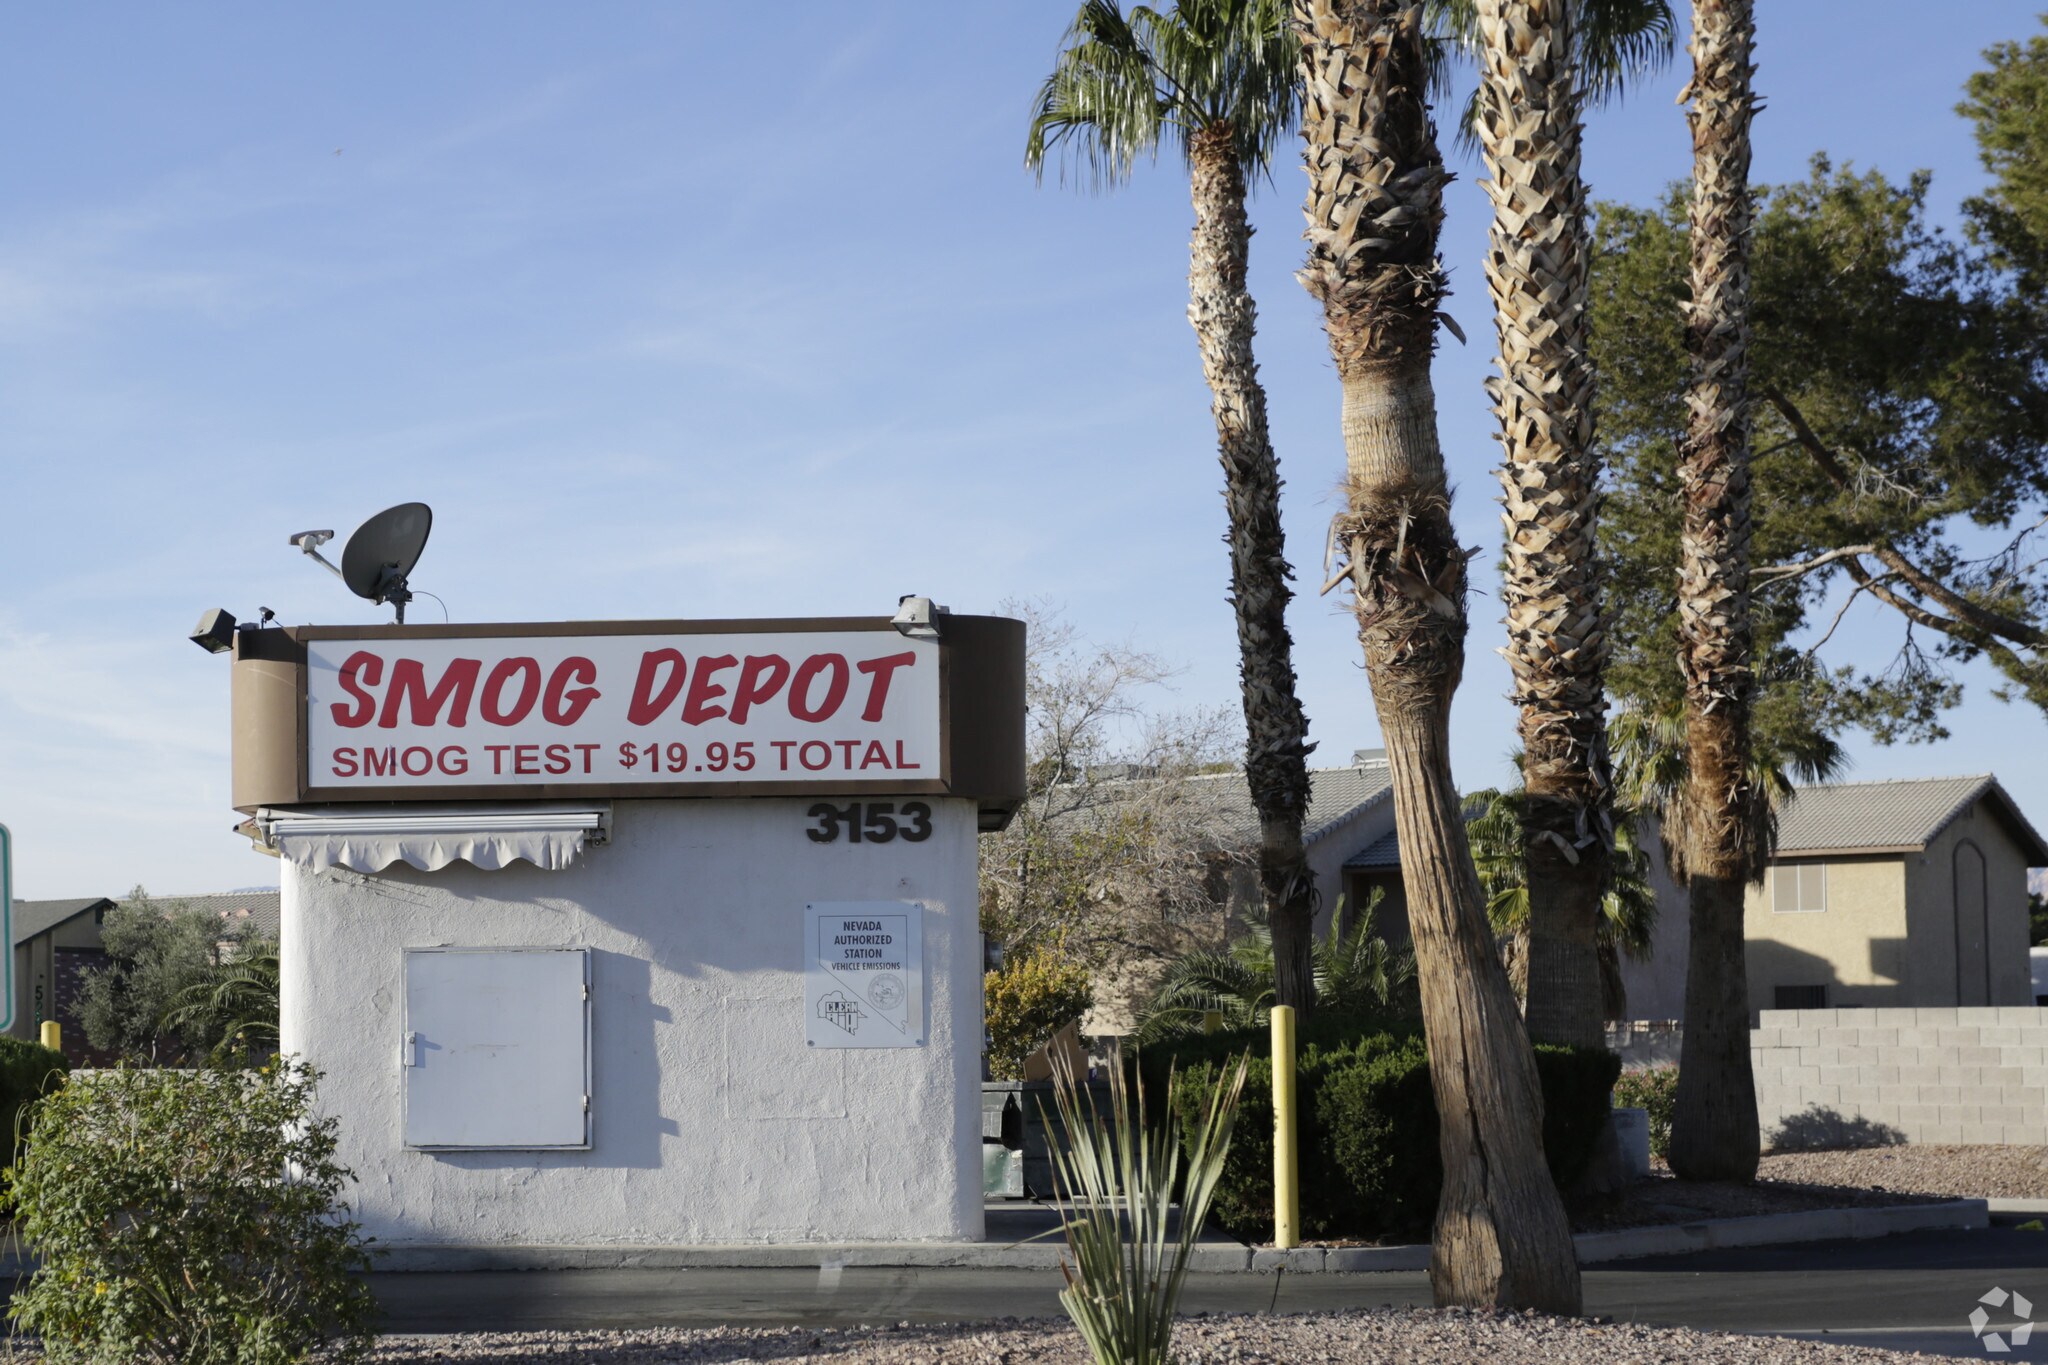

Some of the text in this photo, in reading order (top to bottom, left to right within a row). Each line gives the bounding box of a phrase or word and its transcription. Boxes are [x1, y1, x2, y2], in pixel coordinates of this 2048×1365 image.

[330, 648, 916, 728] SMOG DEPOT
[333, 740, 920, 777] SMOG TEST $19.95 TOTAL
[807, 802, 932, 844] 3153
[843, 921, 882, 931] NEVADA
[834, 935, 892, 945] AUTHORIZED
[844, 949, 882, 959] STATION
[832, 962, 901, 970] VEHICLE EMISSIONS
[826, 1002, 858, 1013] CLEAN
